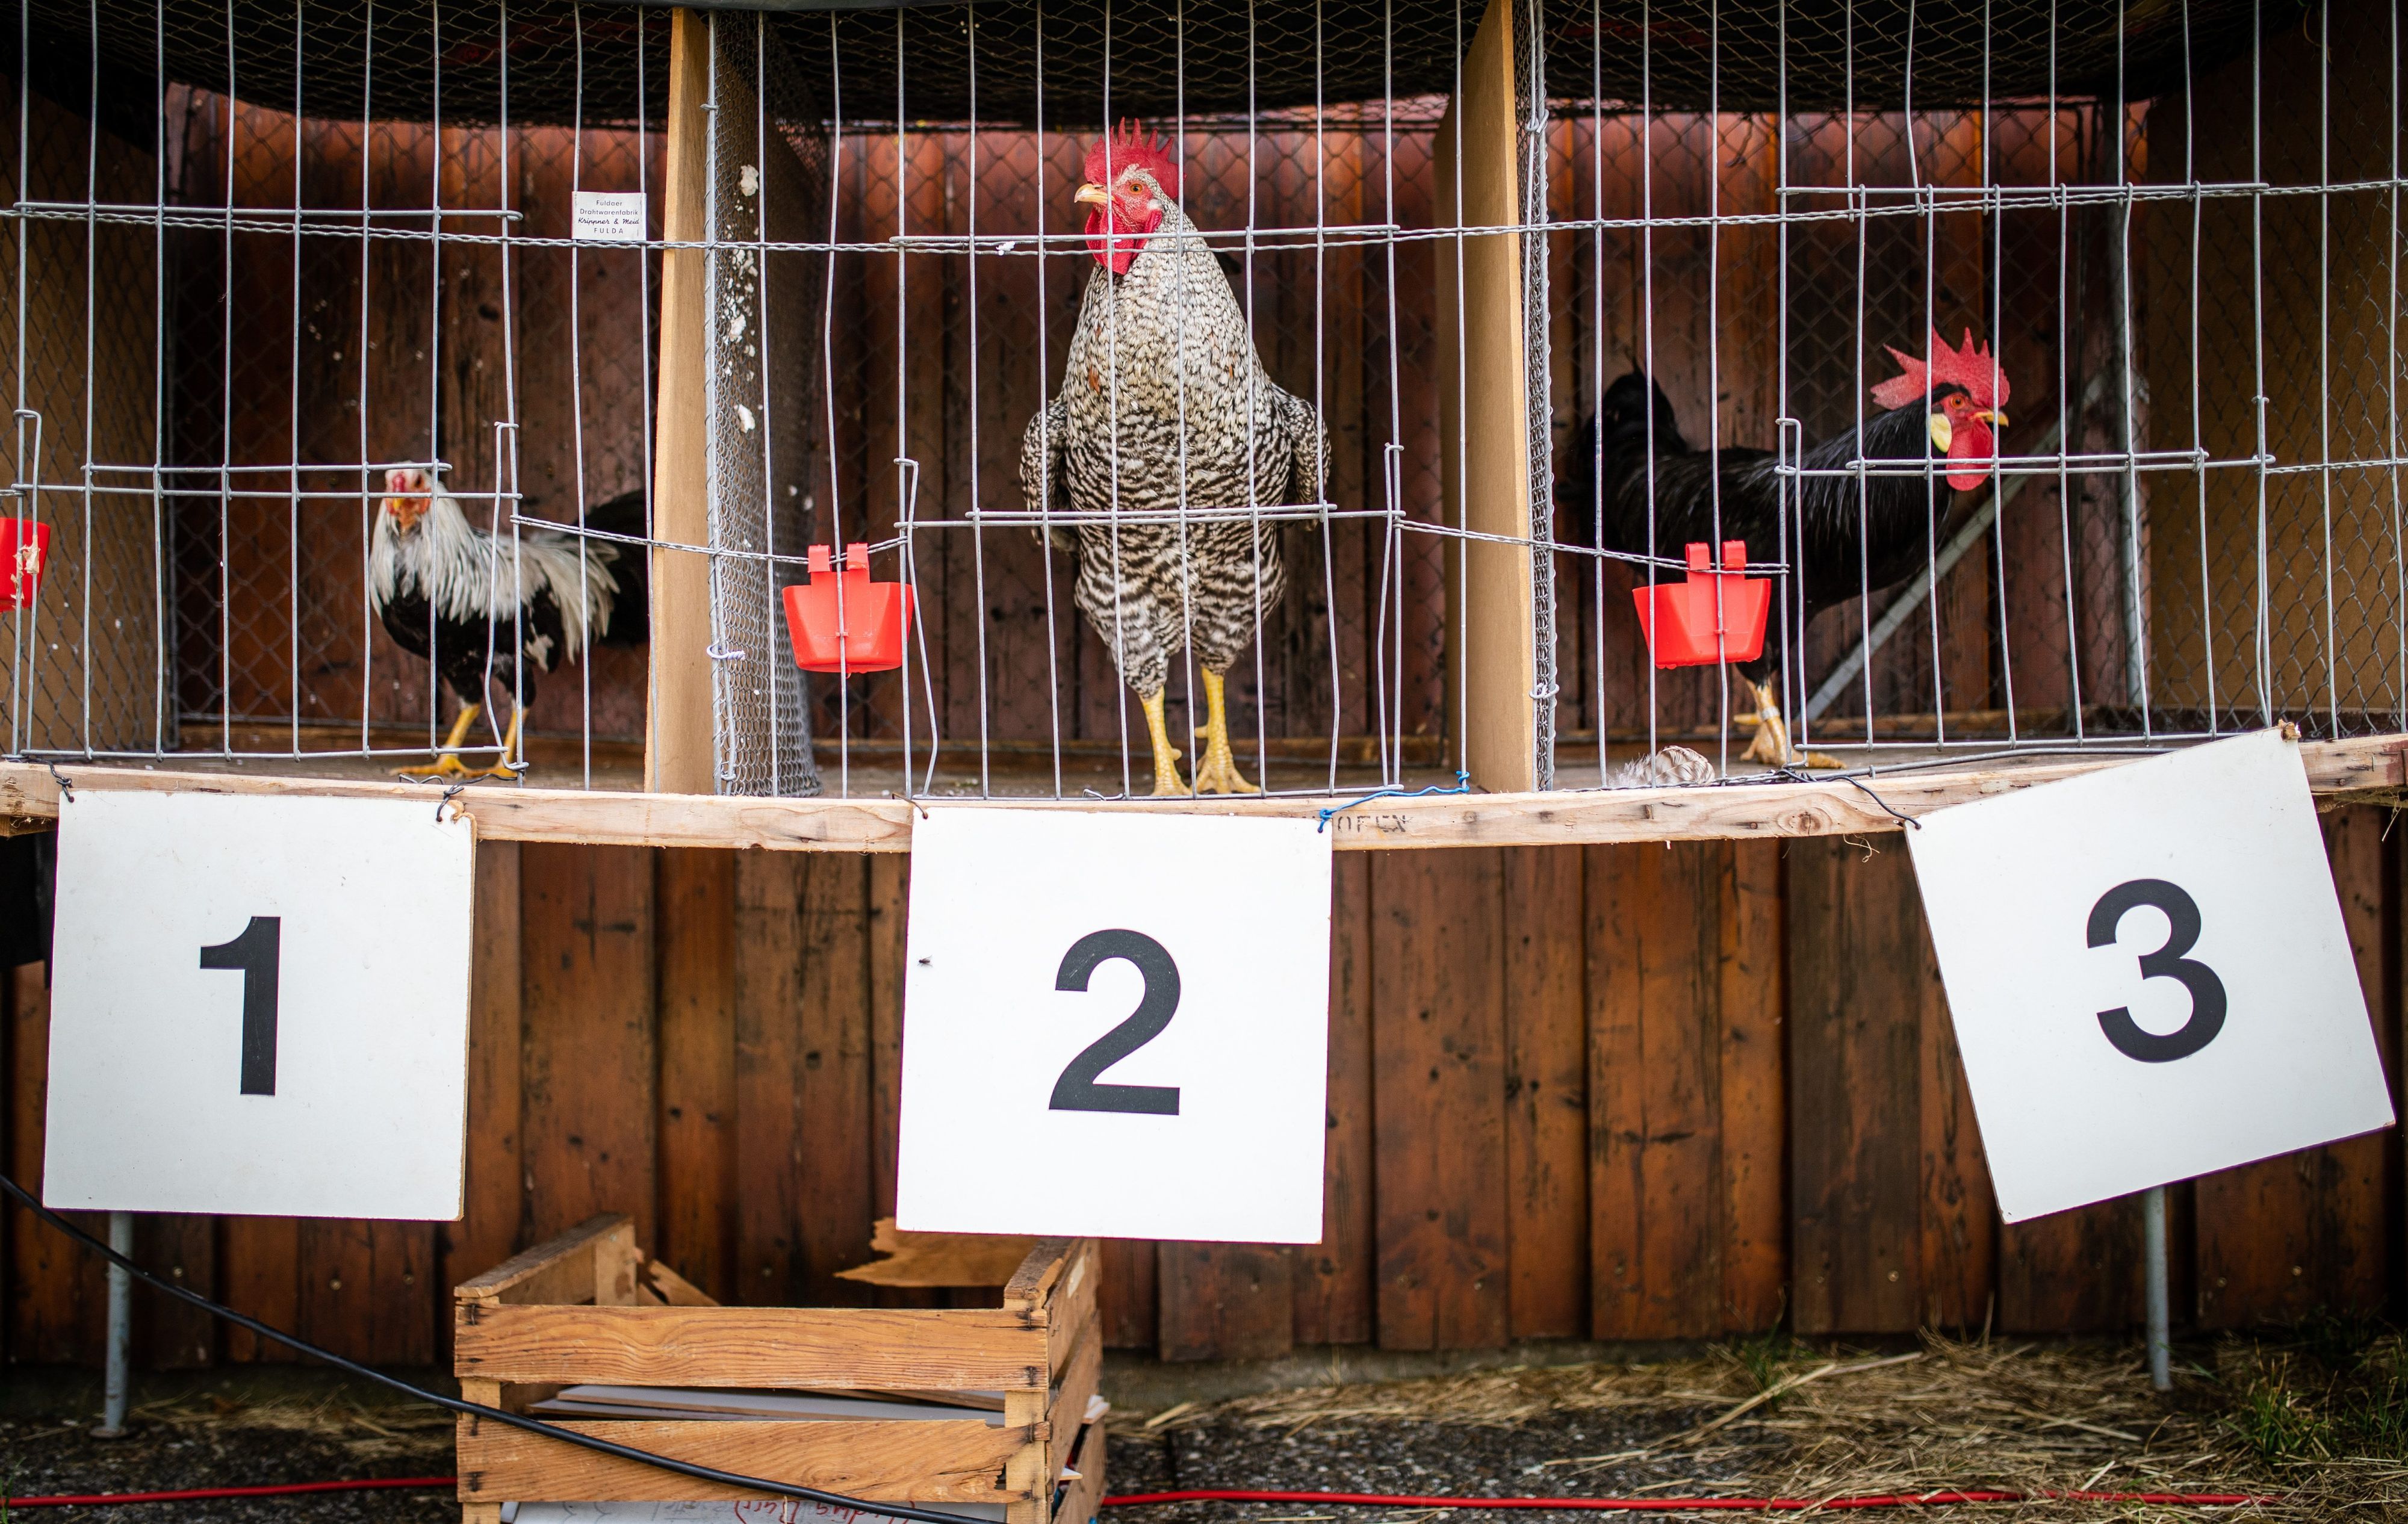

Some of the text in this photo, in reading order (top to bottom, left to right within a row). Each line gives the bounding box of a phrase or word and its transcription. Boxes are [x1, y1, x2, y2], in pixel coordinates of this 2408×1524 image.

[578, 217, 610, 226] Krippner
[200, 917, 281, 1095] 1
[1049, 929, 1180, 1115] 2
[2087, 879, 2226, 1062] 3
